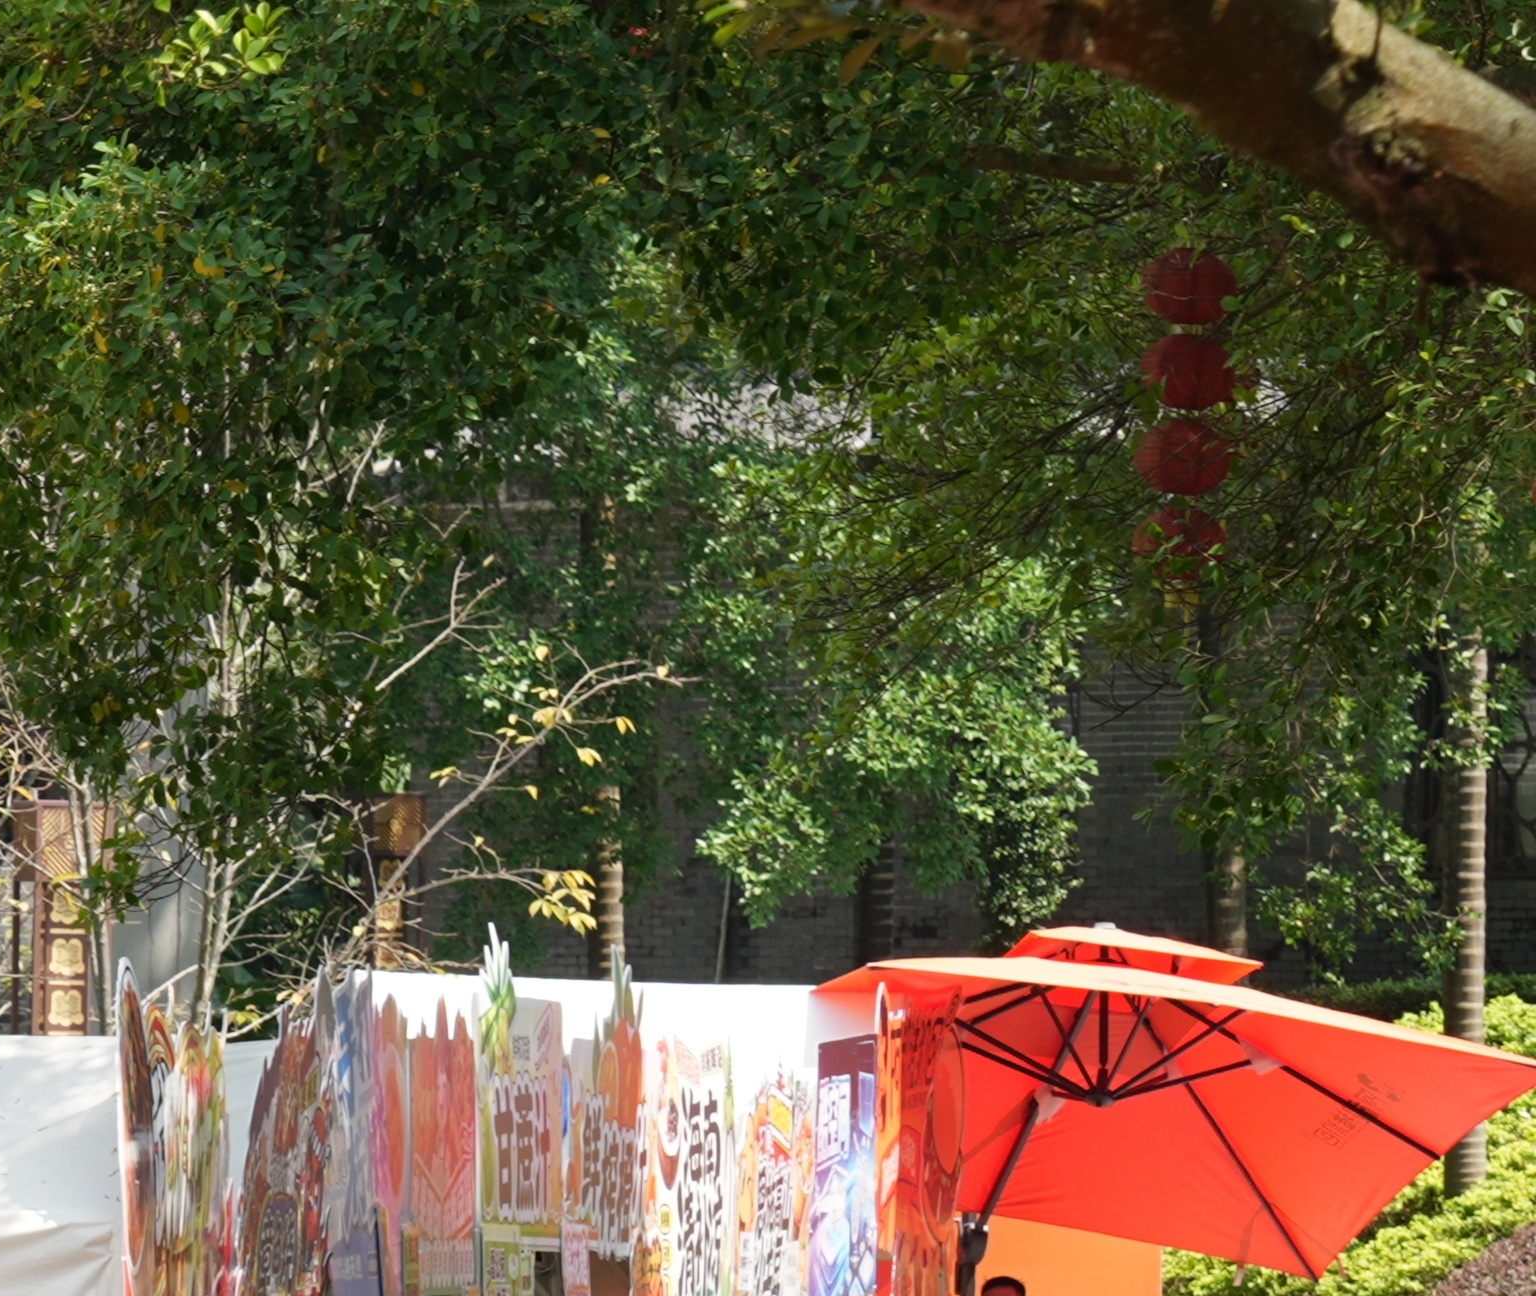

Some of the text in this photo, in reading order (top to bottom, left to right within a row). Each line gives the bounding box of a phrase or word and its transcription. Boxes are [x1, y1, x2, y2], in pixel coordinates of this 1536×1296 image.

[492, 1071, 551, 1226] 甘蔗汁
[681, 1087, 721, 1185] 海南
